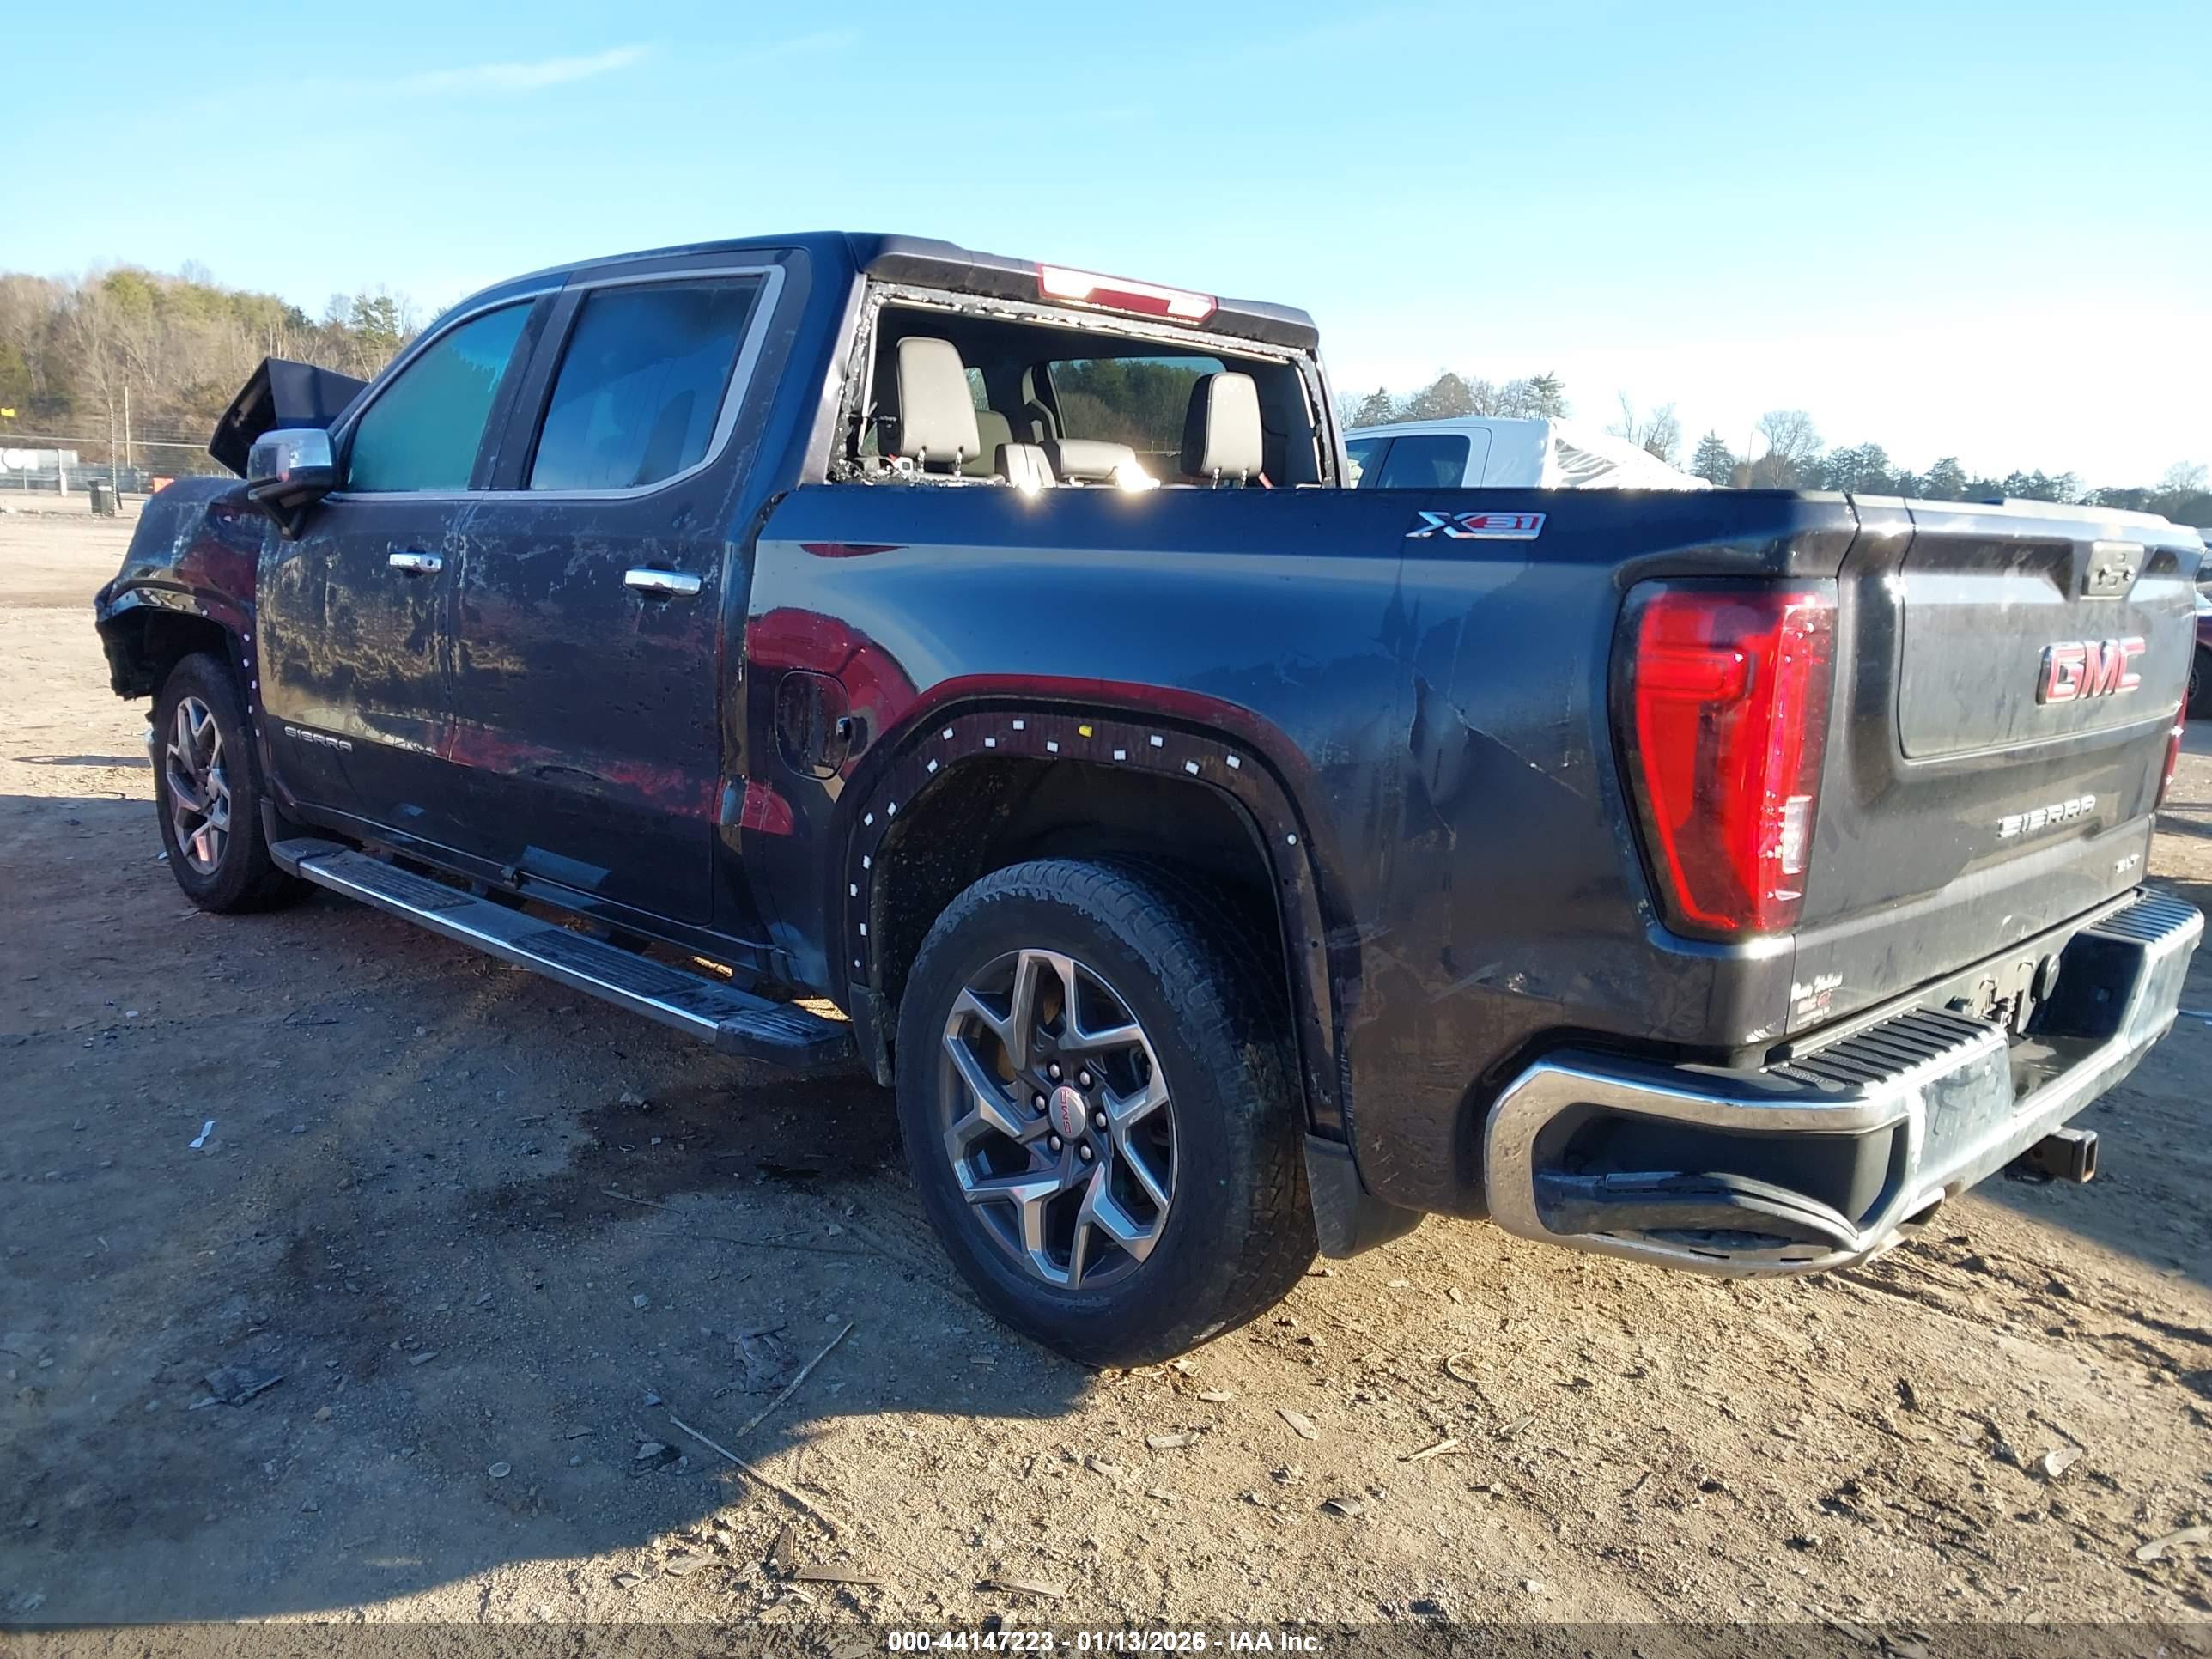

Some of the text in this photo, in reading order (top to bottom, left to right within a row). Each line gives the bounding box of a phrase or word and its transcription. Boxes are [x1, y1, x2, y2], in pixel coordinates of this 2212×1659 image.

[2038, 636, 2146, 705] GMC
[284, 726, 353, 752] SIERRA
[1997, 794, 2096, 838] SIERRA
[1060, 1090, 1072, 1134] GMC
